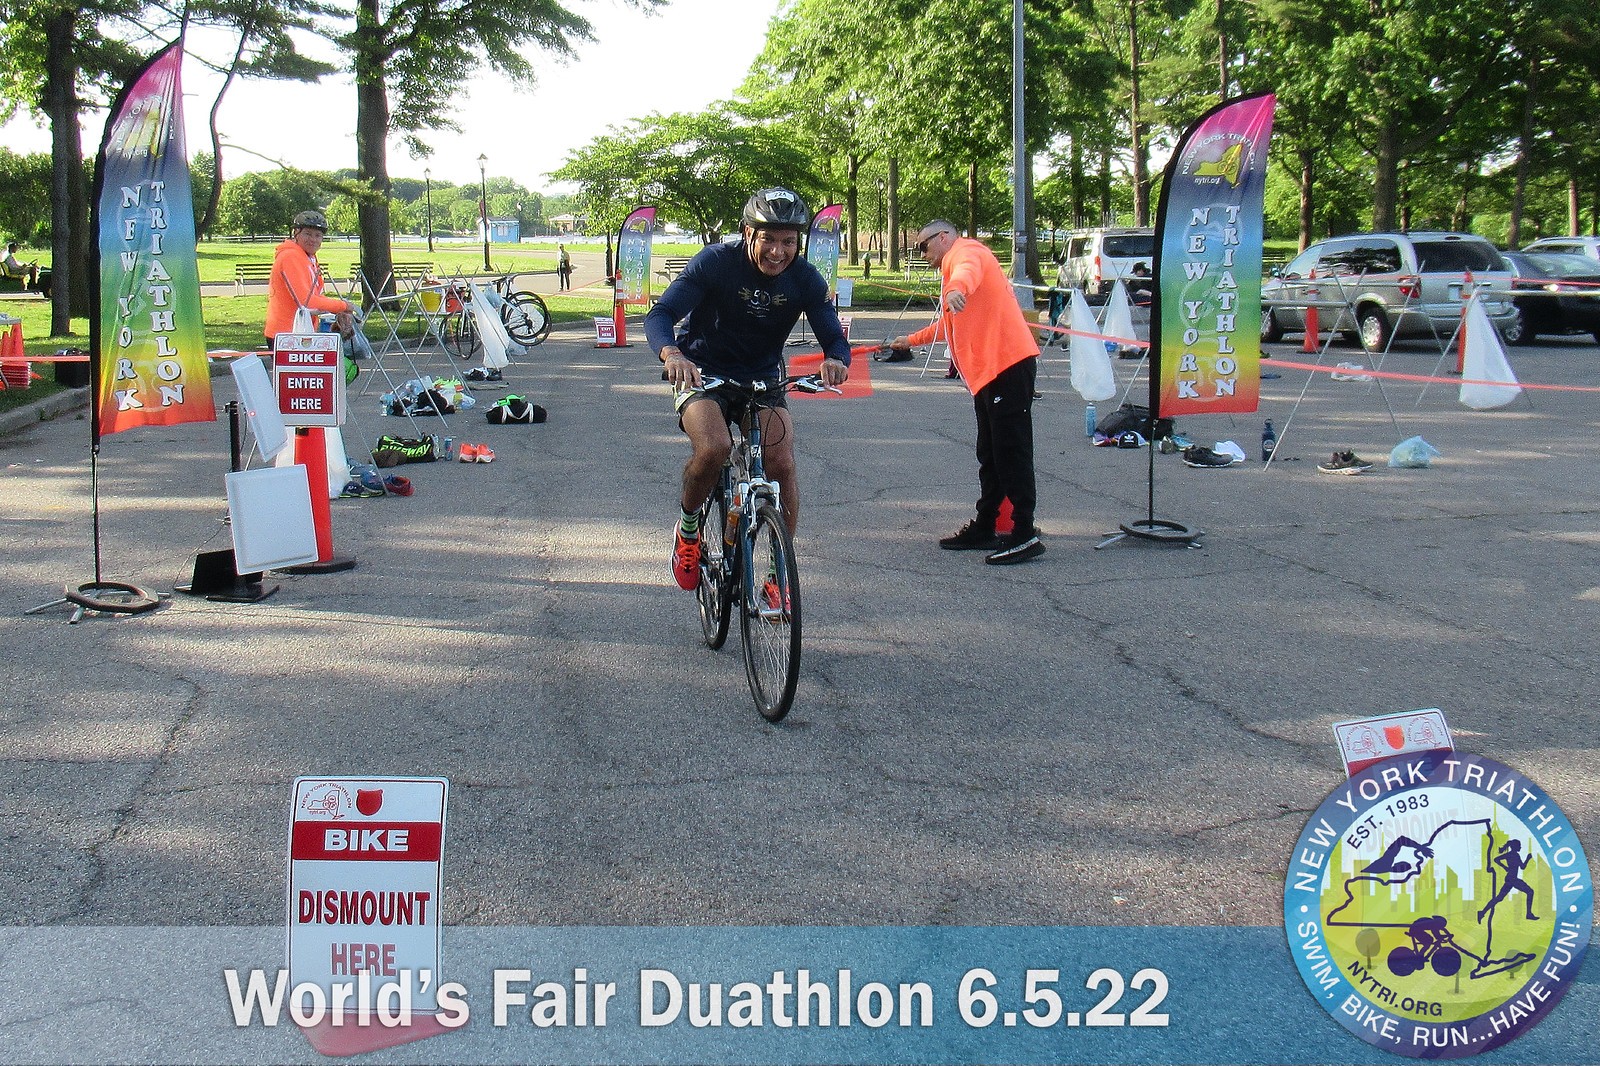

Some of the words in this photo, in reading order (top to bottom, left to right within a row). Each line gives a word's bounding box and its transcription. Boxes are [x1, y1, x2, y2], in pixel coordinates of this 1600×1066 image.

[1182, 148, 1197, 175] NEW
[121, 185, 142, 272] NEW
[1183, 207, 1210, 281] NEW
[147, 180, 185, 407] TRIATHLON
[1215, 205, 1241, 397] TRIATHLON
[114, 294, 143, 411] YORK
[289, 353, 325, 363] BIKE
[1177, 300, 1203, 399] YORK
[287, 377, 324, 389] ENTER
[290, 398, 322, 410] HERE
[301, 792, 310, 808] NEW
[310, 783, 328, 792] YORK
[328, 783, 352, 808] TRIATHLON
[324, 829, 410, 852] BIKE
[298, 890, 431, 926] DISMOUNT
[331, 943, 397, 976] HERE
